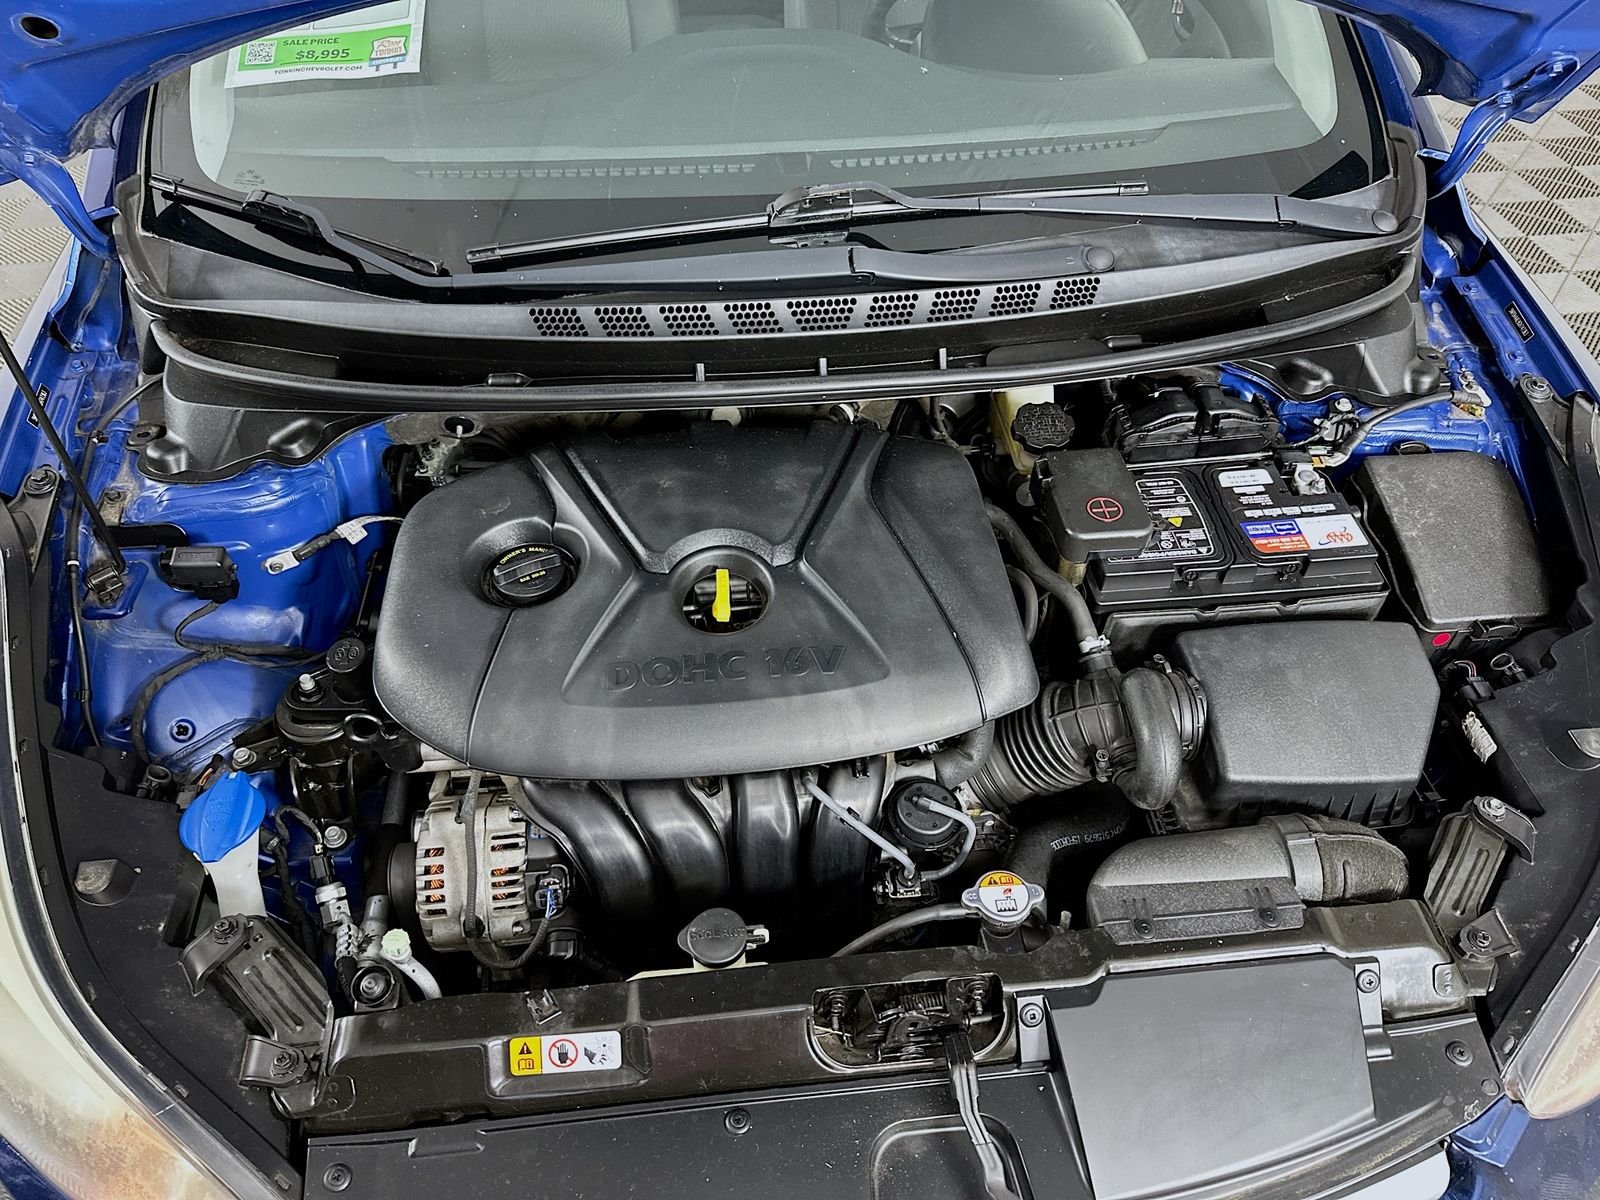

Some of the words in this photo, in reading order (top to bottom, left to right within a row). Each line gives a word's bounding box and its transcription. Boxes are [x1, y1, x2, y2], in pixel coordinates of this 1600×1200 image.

[283, 38, 309, 46] SALE
[310, 37, 340, 45] PRICE
[295, 48, 351, 61] $8,995
[274, 65, 363, 75] TONKINCHEVROLET.COM
[606, 651, 747, 692] DOHC
[765, 645, 847, 678] 16V
[690, 927, 746, 941] COOLANT
